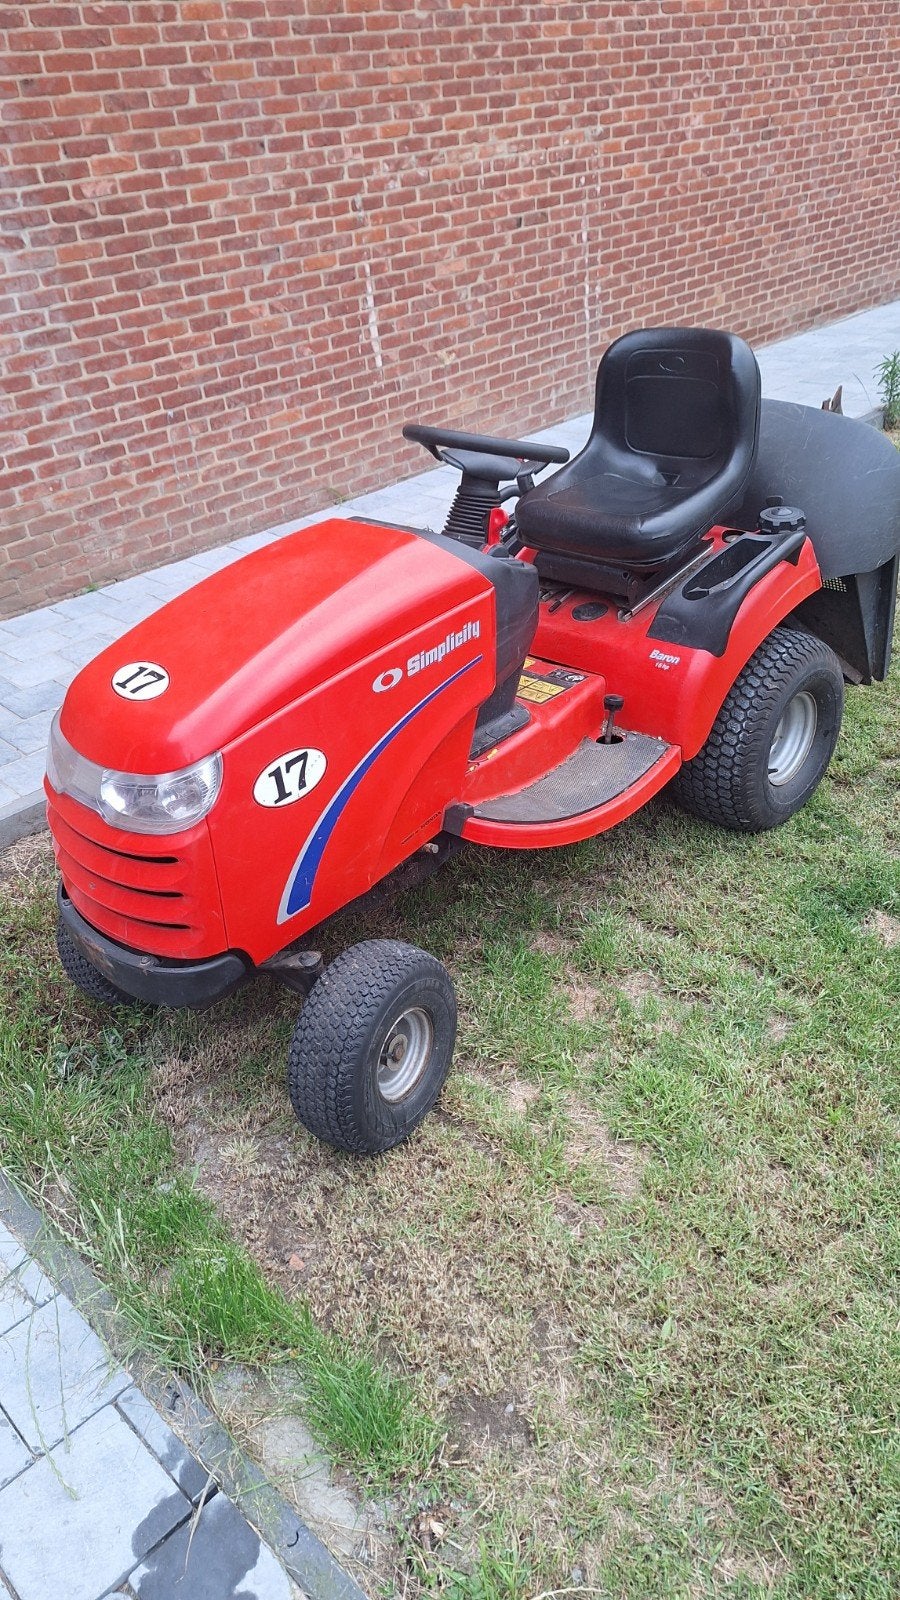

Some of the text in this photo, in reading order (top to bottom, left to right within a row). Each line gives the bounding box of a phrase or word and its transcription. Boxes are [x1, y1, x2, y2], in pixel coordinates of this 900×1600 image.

[406, 620, 480, 677] Simplicity
[649, 649, 681, 664] Baron
[115, 666, 166, 694] 17
[268, 751, 309, 805] 17
